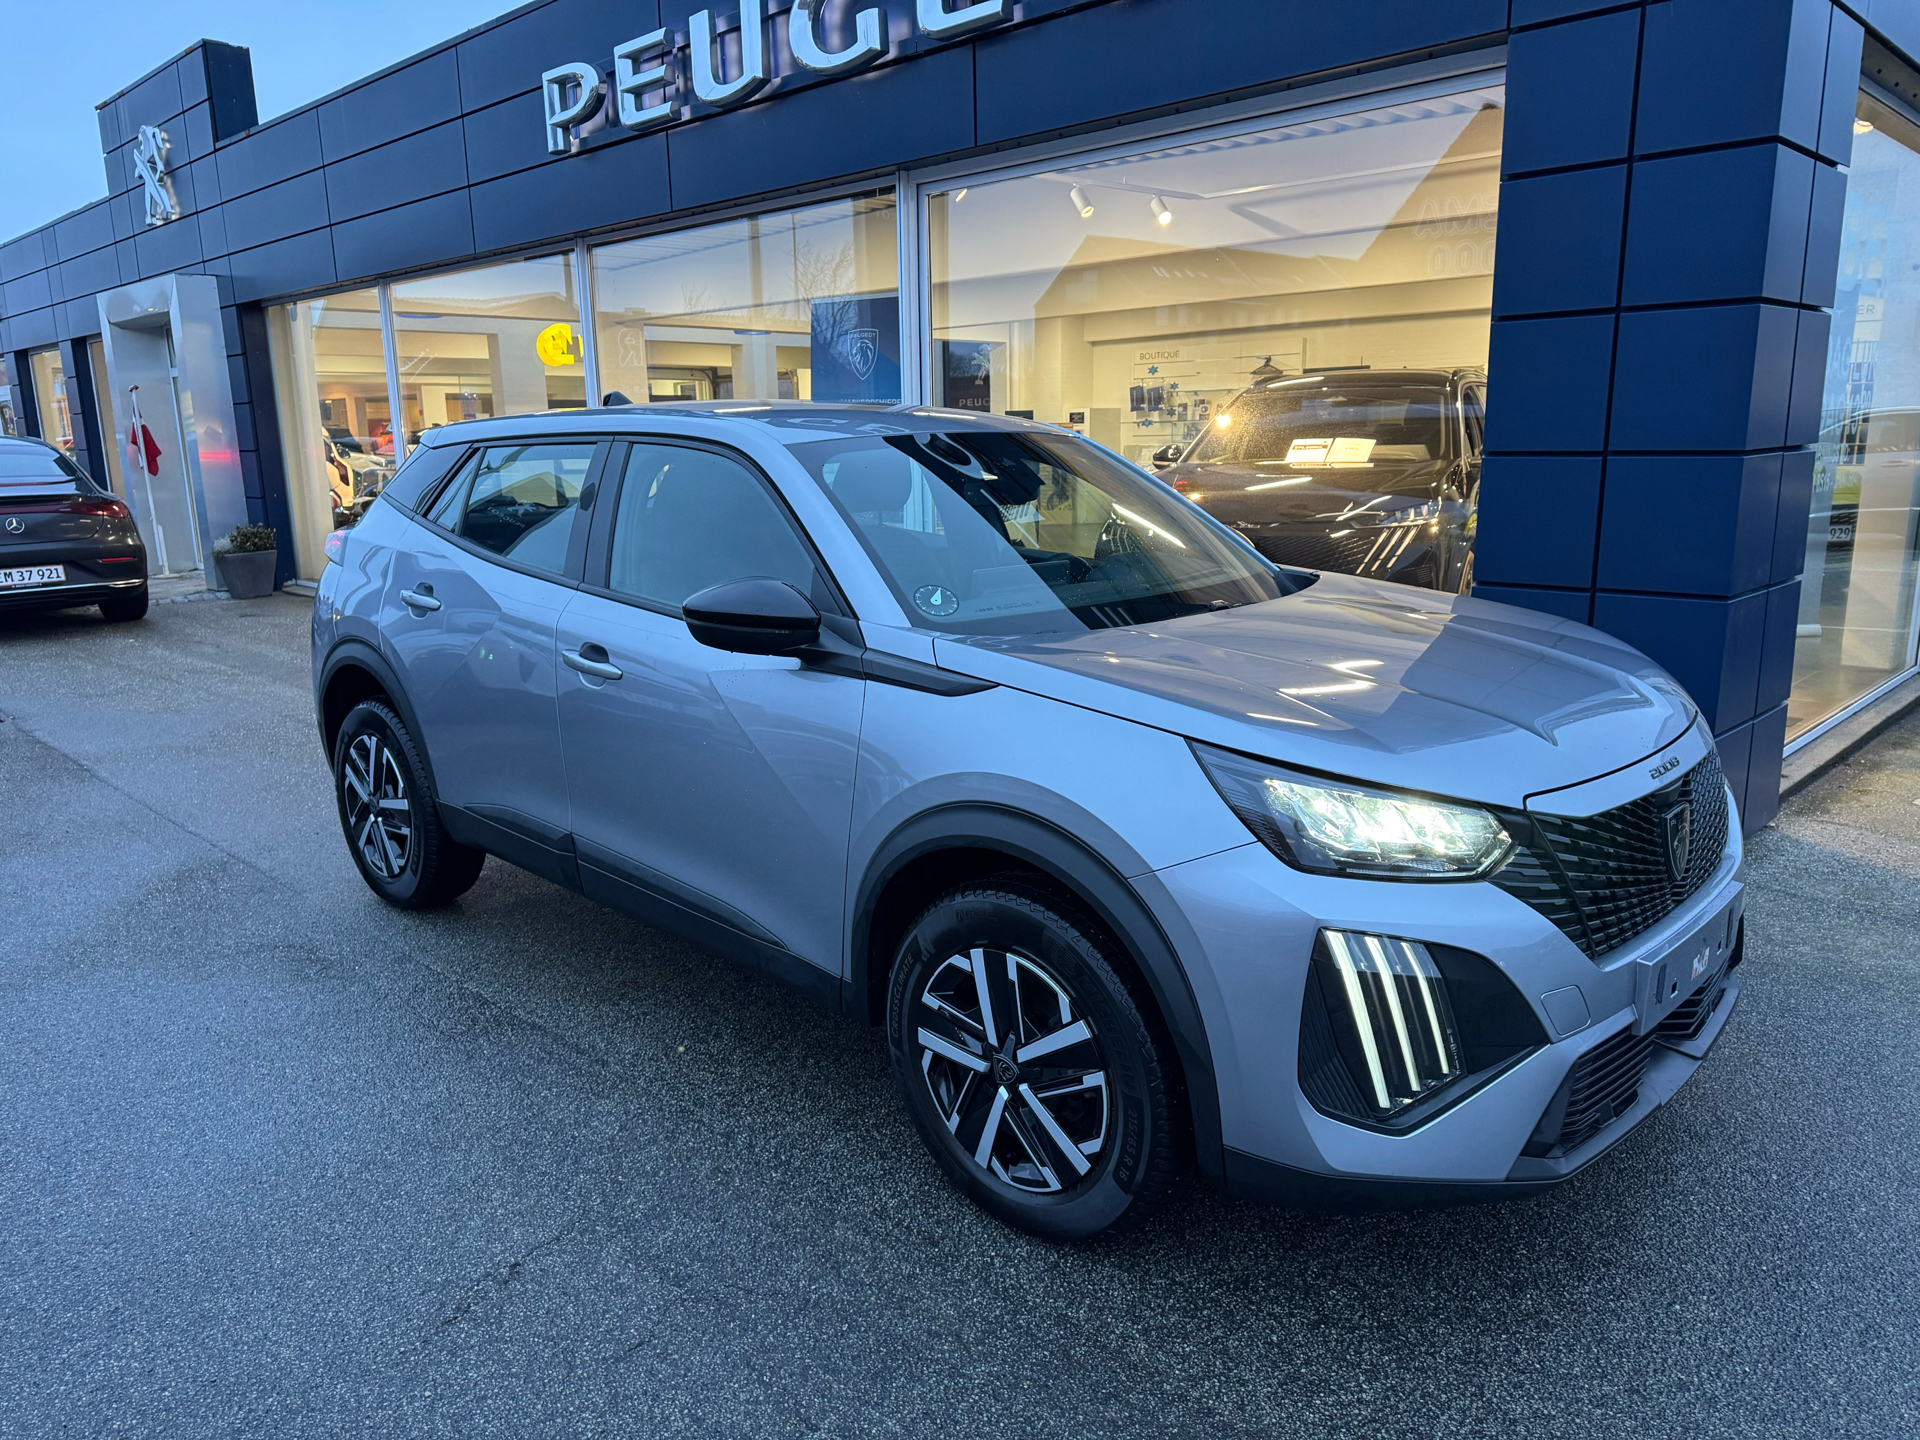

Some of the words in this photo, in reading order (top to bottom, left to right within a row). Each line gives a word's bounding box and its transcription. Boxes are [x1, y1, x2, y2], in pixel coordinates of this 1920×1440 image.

[1140, 350, 1180, 360] BOUTIQUE
[16, 570, 33, 582] 37
[37, 568, 62, 580] 921
